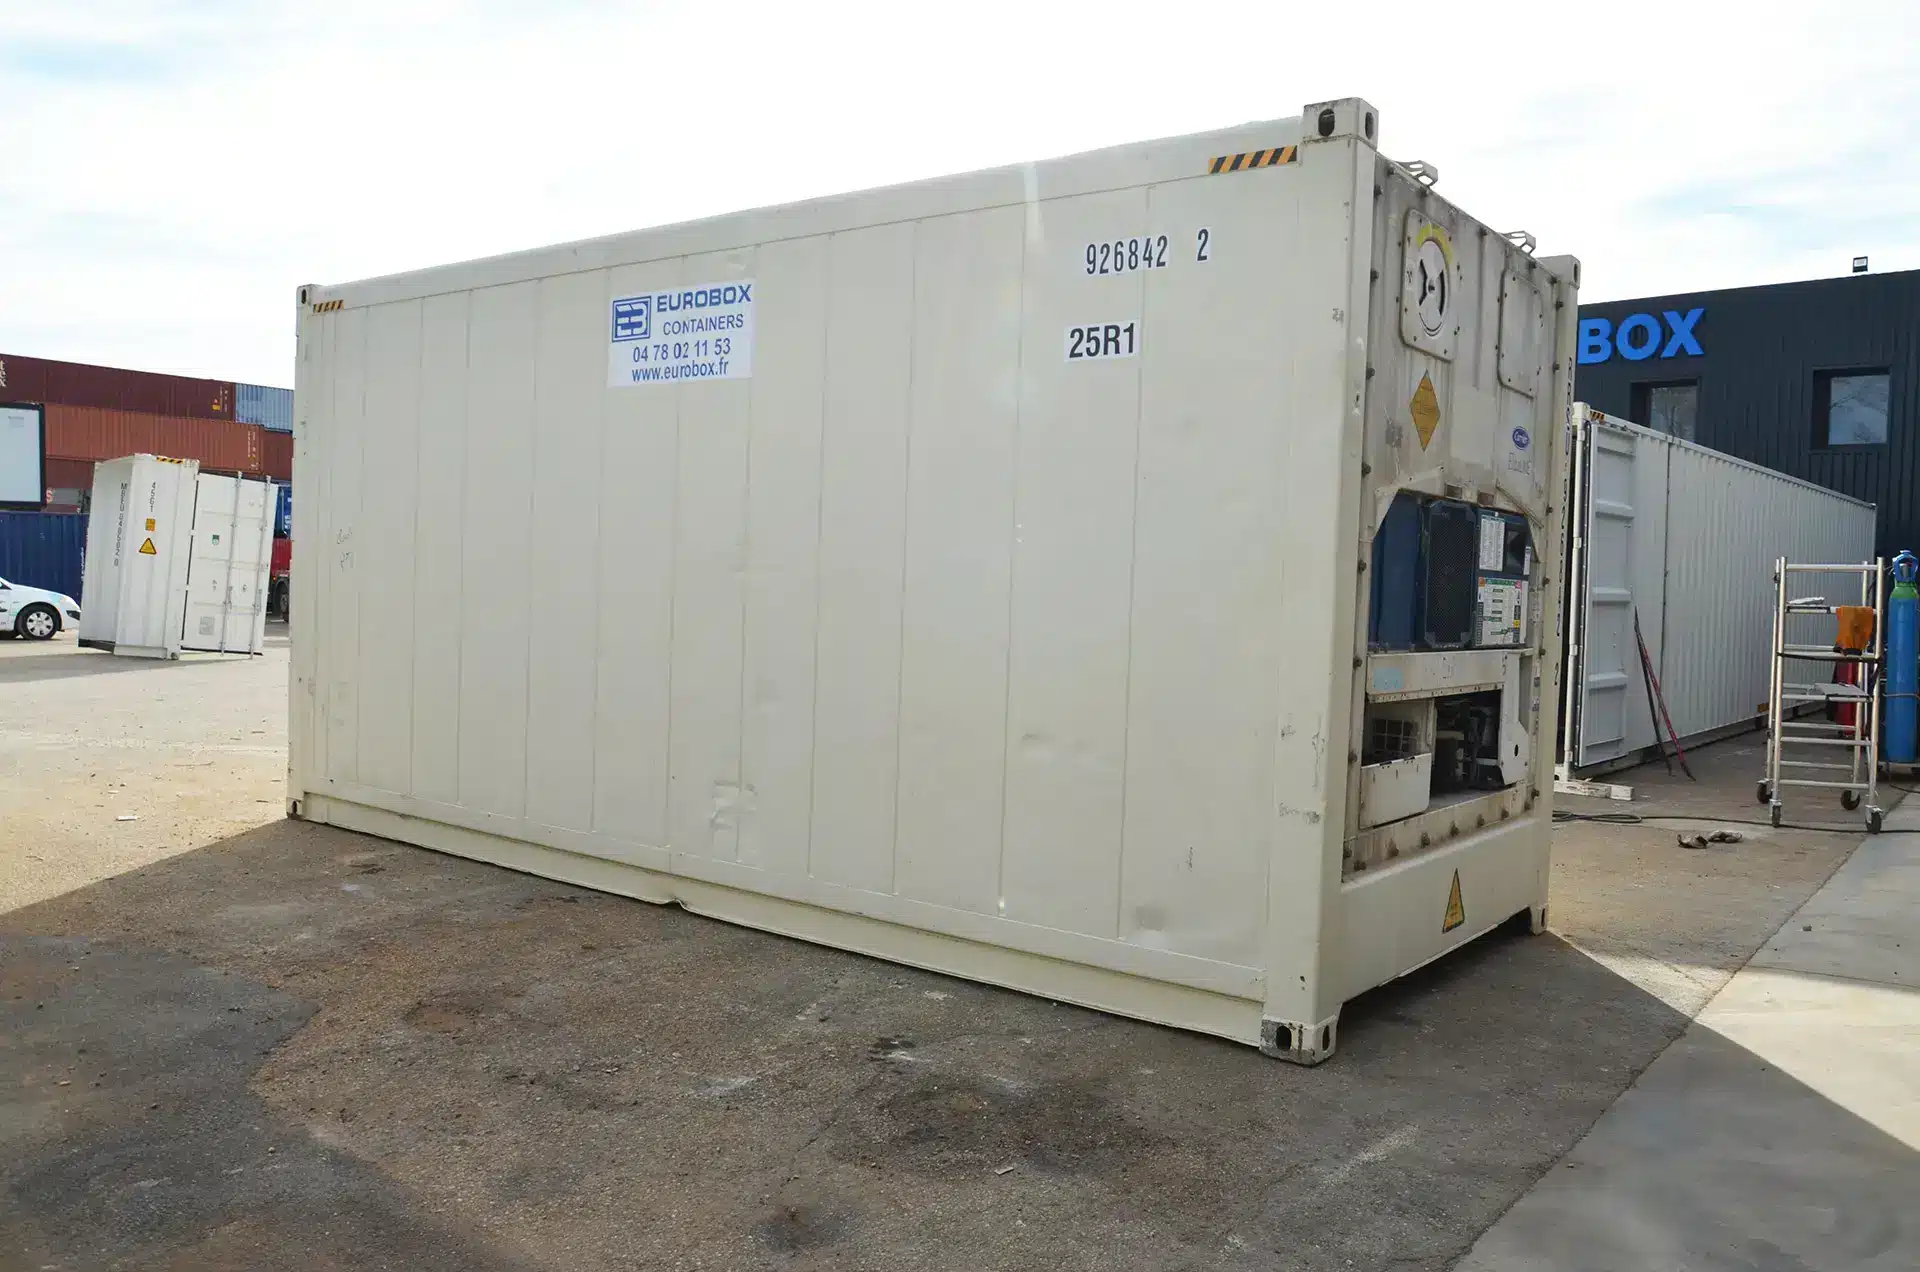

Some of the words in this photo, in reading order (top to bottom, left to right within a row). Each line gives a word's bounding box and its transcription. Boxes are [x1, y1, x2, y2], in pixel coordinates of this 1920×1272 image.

[1086, 235, 1168, 275] 926842
[1197, 228, 1209, 262] 2
[657, 284, 752, 312] EUROBOX
[663, 313, 744, 336] CONTAINERS
[1577, 308, 1704, 364] BOX
[632, 346, 649, 363] 04
[653, 343, 669, 361] 78
[673, 341, 689, 359] 02
[694, 339, 708, 357] 11
[714, 337, 731, 356] 53
[1069, 322, 1135, 358] 25R1
[632, 356, 729, 382] www.eurobox.fr
